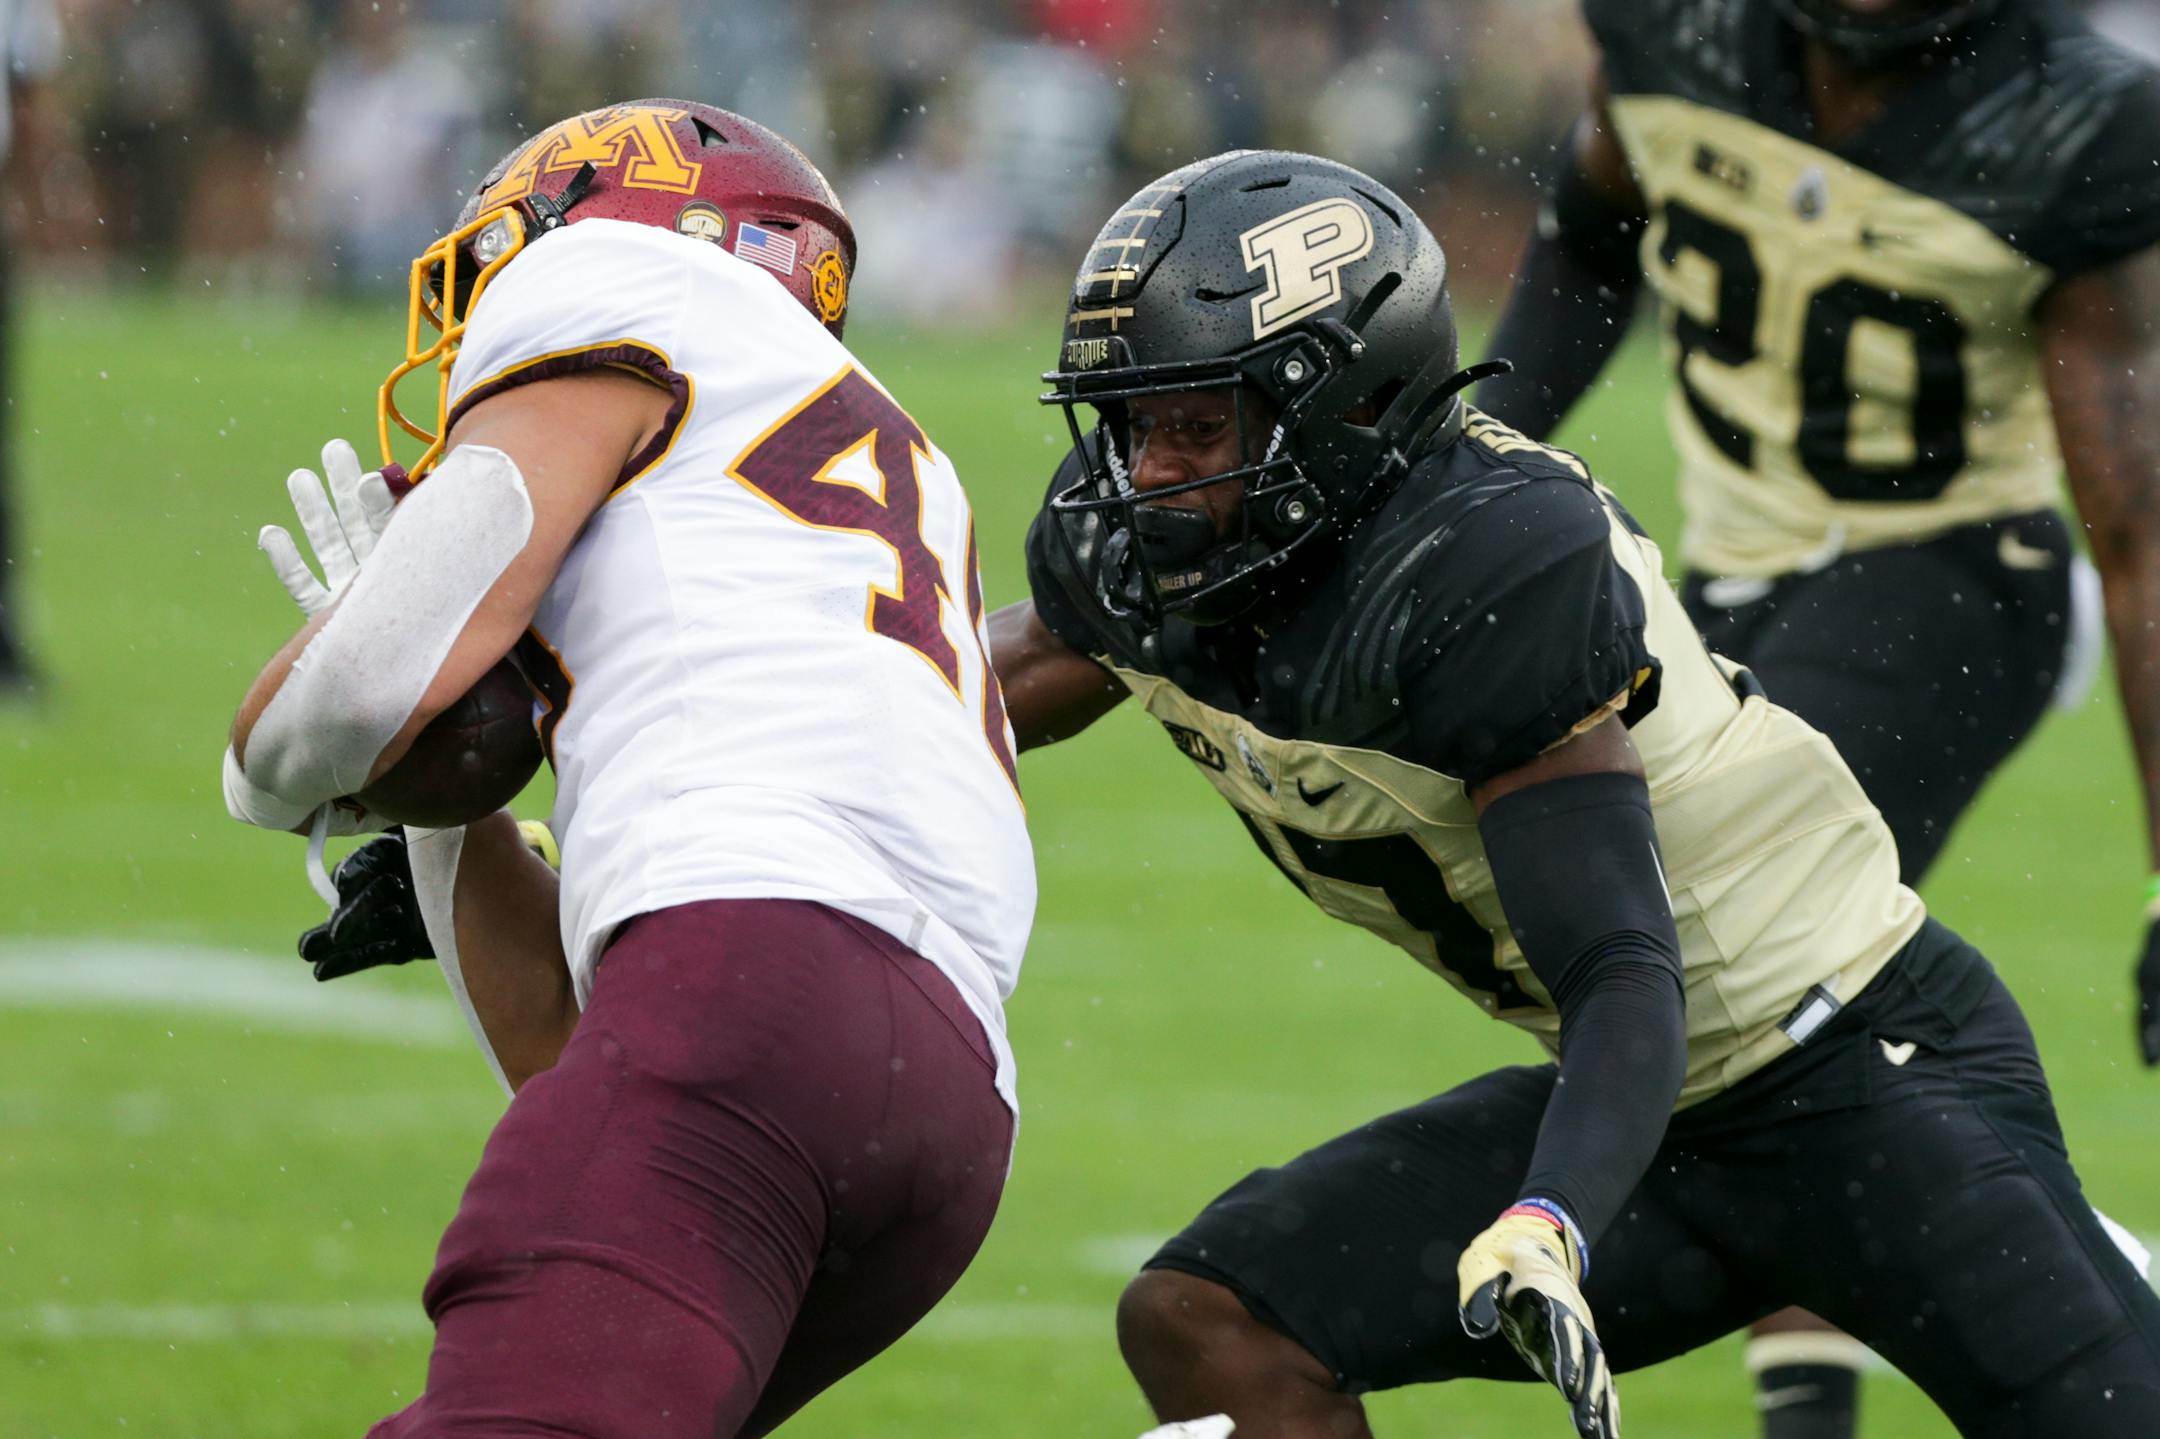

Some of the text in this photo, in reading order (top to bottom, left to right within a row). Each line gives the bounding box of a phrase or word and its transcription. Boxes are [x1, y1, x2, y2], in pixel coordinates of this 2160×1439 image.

[1239, 197, 1376, 341] P
[1065, 339, 1108, 370] PURDUE
[1660, 196, 1968, 503] 20
